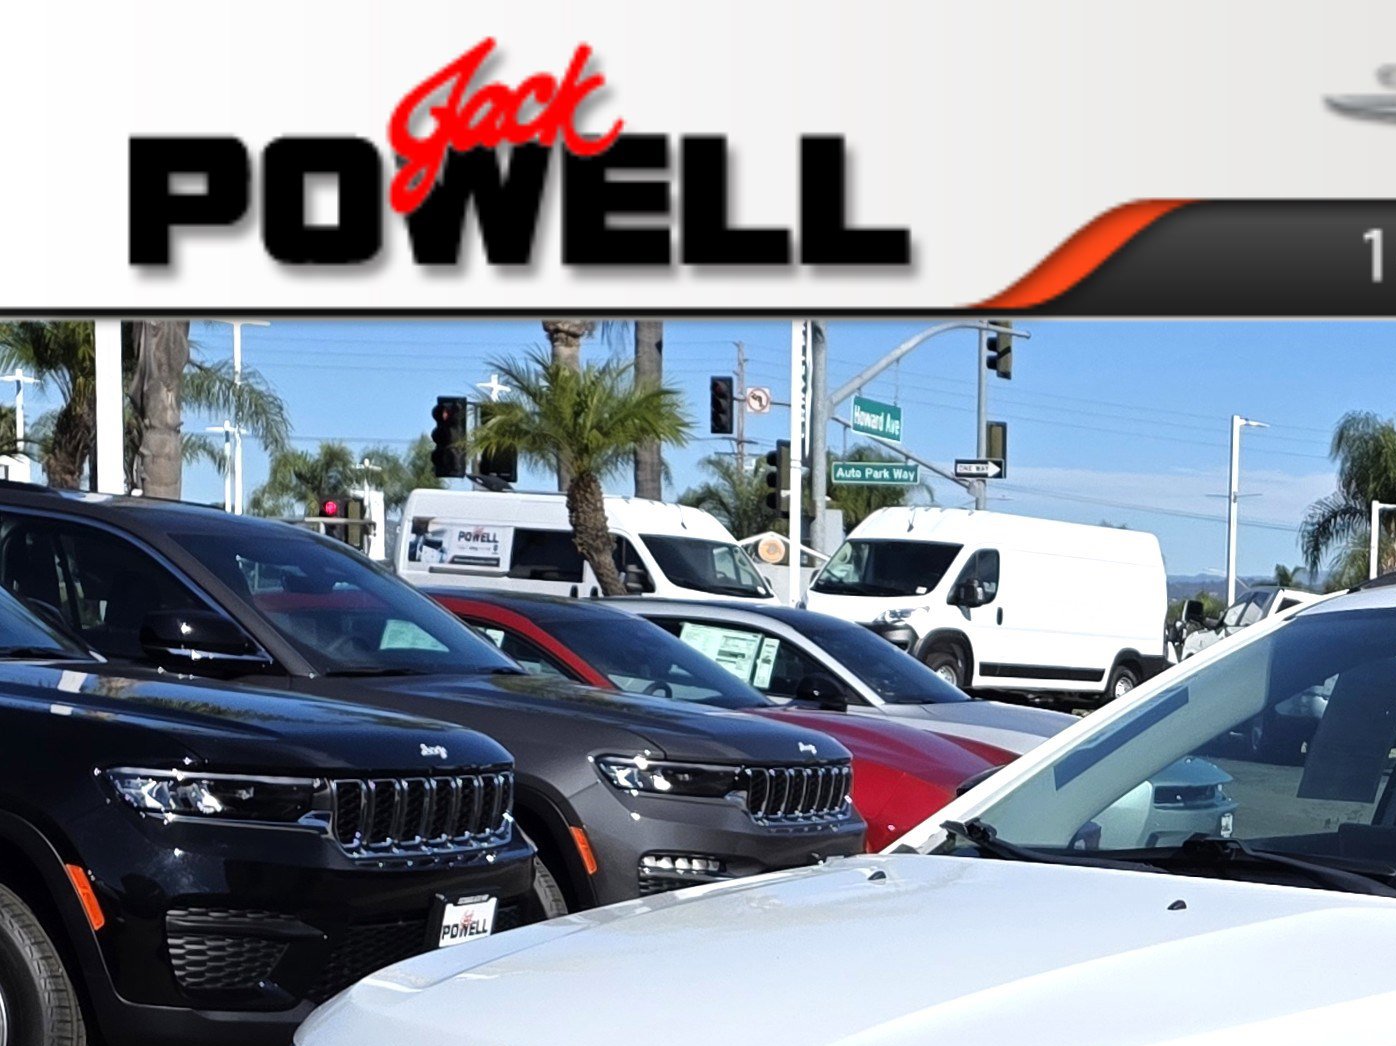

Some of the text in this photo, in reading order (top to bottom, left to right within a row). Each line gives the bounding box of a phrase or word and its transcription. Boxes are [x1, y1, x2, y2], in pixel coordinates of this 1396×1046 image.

[854, 404, 901, 436] Howard Ave
[836, 467, 916, 481] Auto Park Way
[458, 531, 499, 543] POWELL
[442, 918, 488, 940] POWELL
